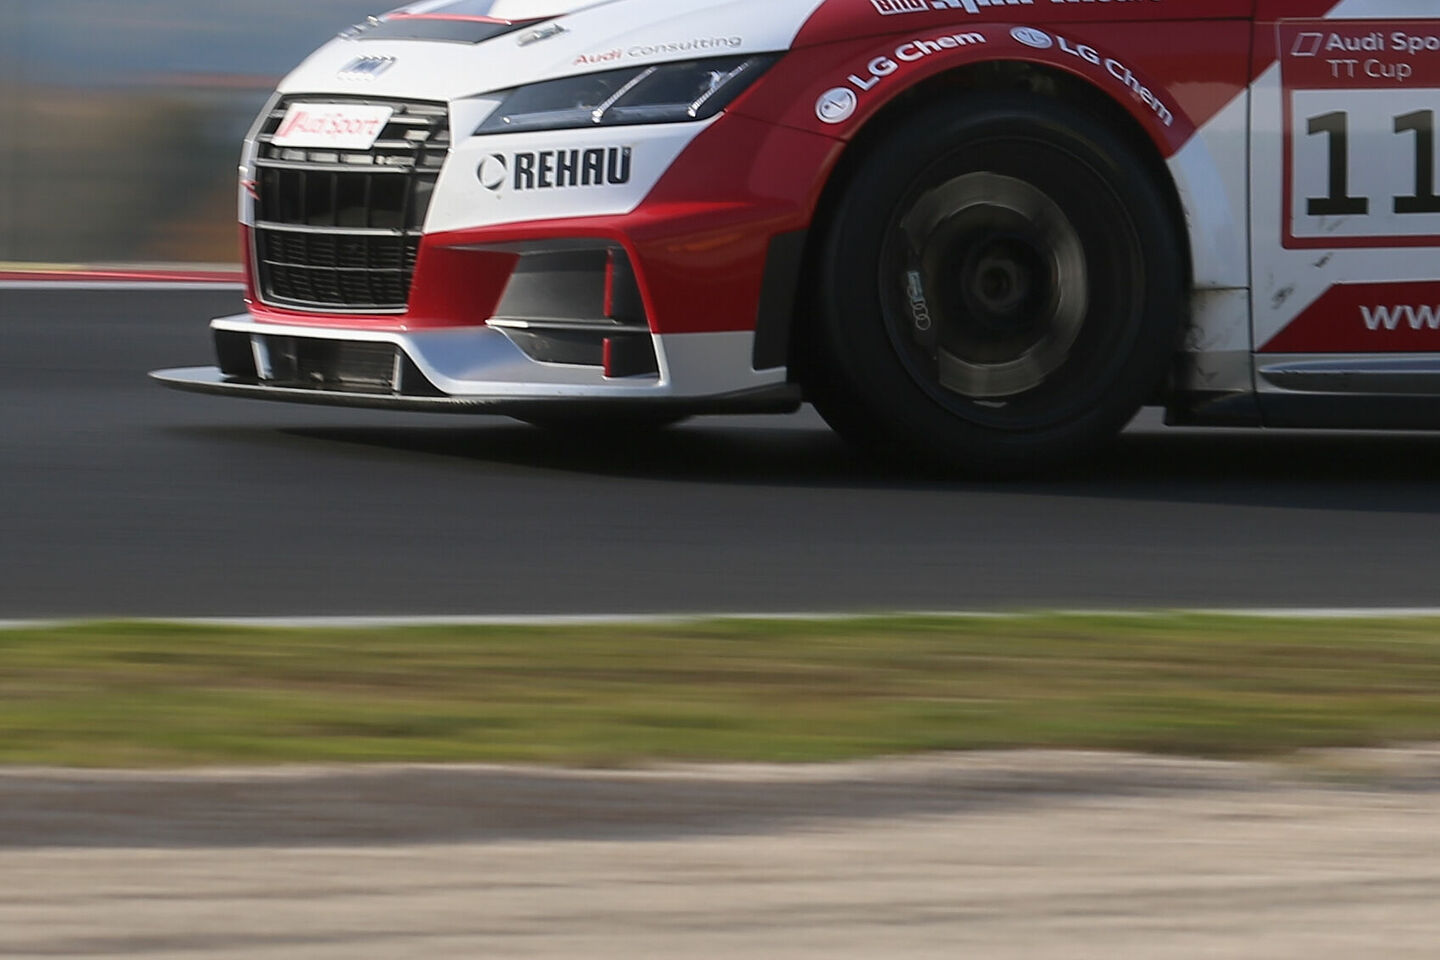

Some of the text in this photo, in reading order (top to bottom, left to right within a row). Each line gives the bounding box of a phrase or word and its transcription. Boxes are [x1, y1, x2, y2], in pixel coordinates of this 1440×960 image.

[574, 36, 743, 66] Audi Consulting
[1325, 32, 1384, 51] Audi
[847, 32, 986, 91] LG Chem
[1326, 58, 1413, 81] TT Cup
[1055, 36, 1174, 128] LG Chem
[513, 146, 632, 190] REHAU
